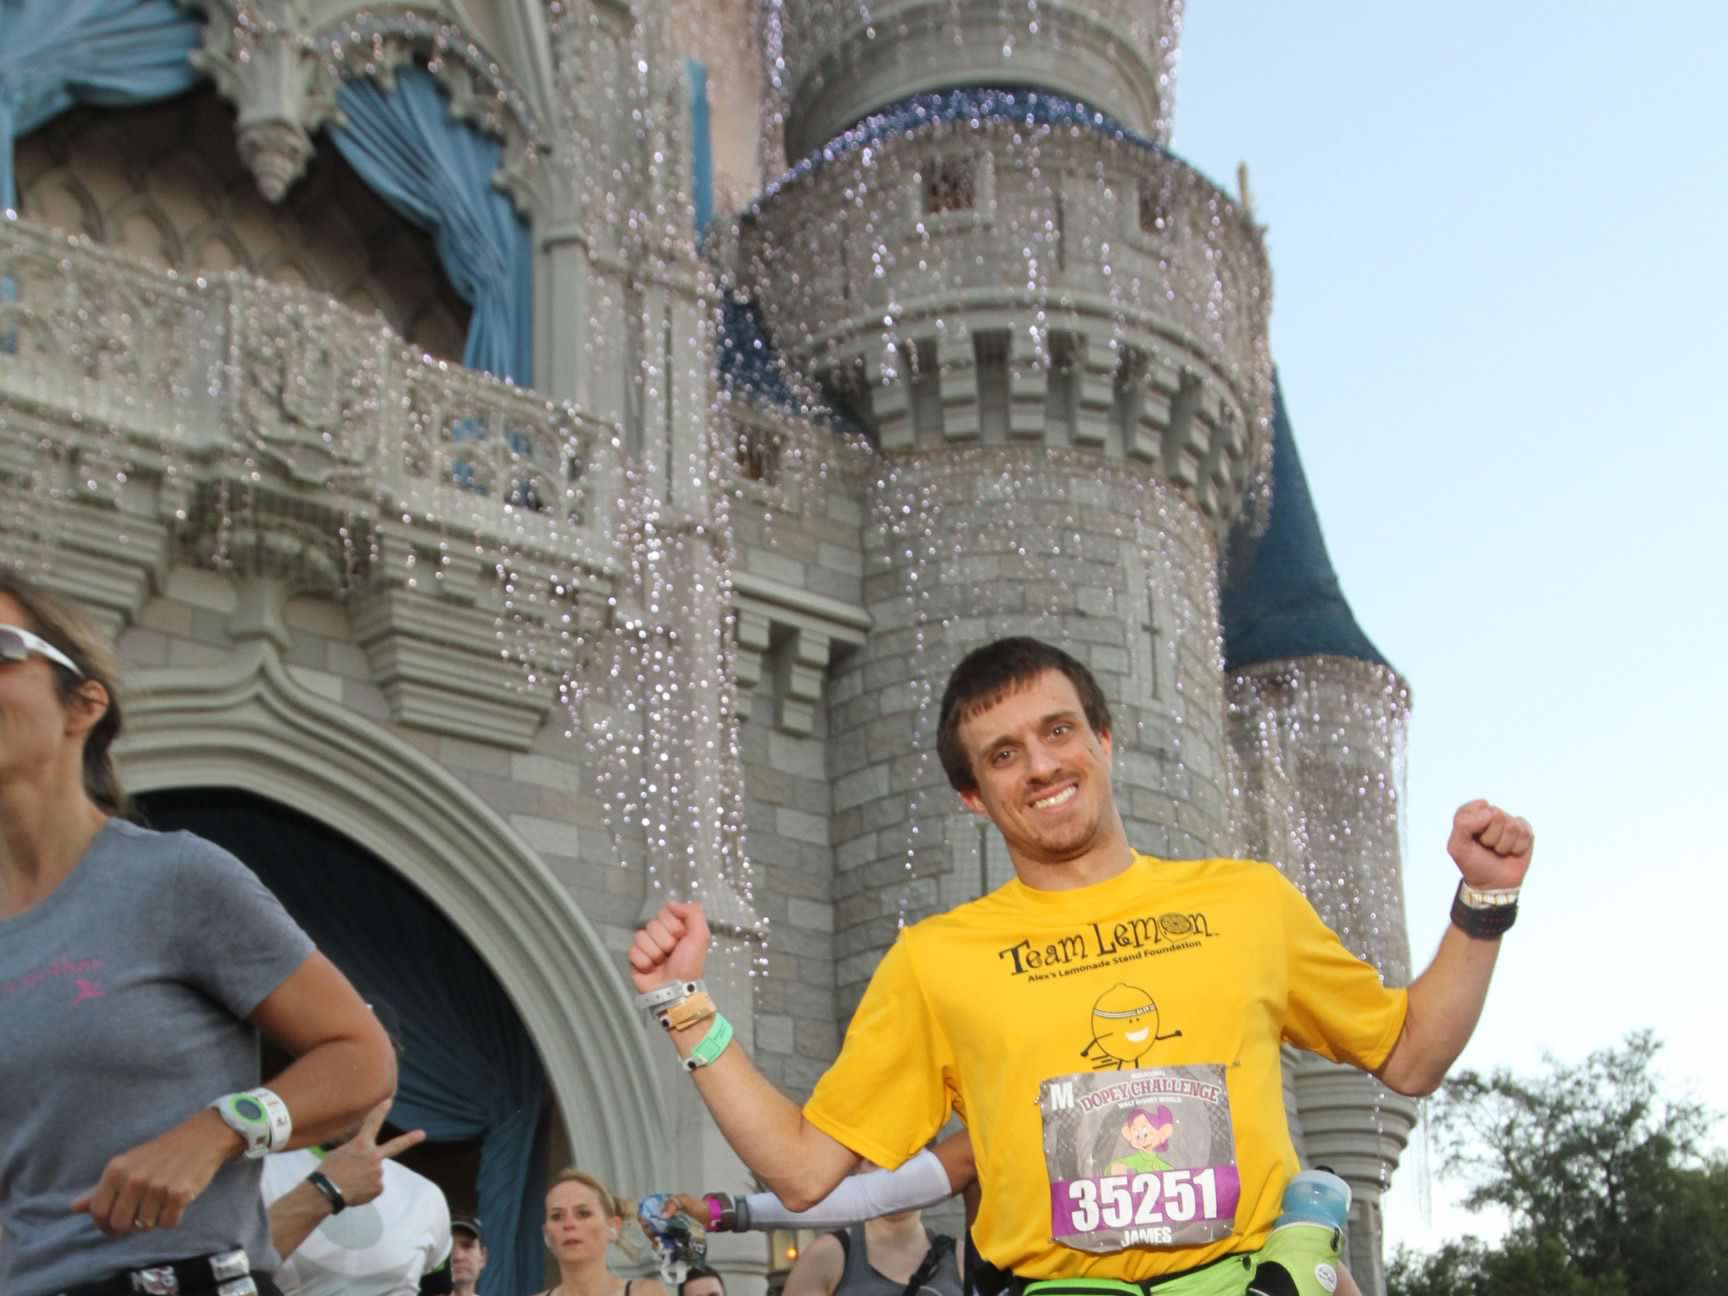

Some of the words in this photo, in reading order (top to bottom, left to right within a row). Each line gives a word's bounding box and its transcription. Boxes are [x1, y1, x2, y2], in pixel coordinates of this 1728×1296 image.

[998, 938, 1088, 976] Team
[1087, 912, 1213, 957] Lemon
[1028, 972, 1058, 982] Alex's
[1059, 960, 1111, 977] Lemonade
[1112, 951, 1142, 964] Stand
[1144, 940, 1202, 957] Foundation
[1050, 1082, 1074, 1110] M
[1080, 1083, 1131, 1111] DOPEY
[1131, 1078, 1221, 1103] CHALLENGE
[1068, 1168, 1217, 1232] 35251
[1120, 1227, 1172, 1247] JAMES
